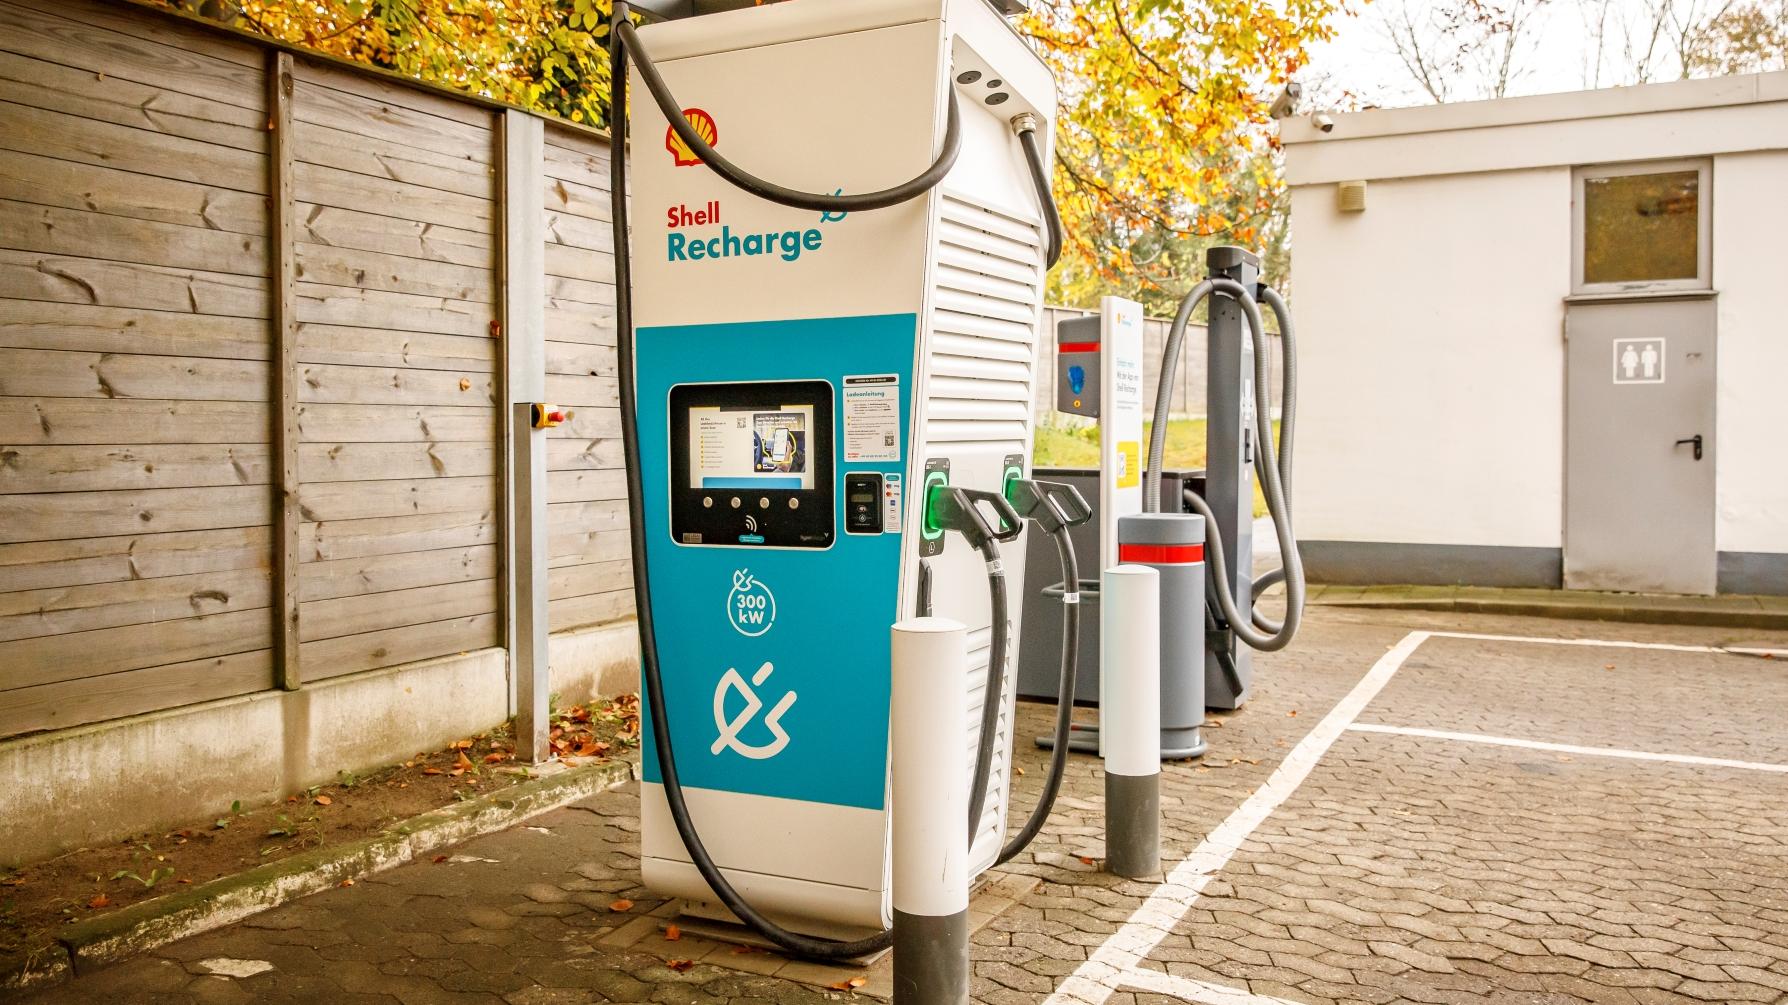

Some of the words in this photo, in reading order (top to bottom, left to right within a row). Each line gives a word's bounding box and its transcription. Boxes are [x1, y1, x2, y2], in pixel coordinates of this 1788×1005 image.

[667, 201, 720, 228] Shell
[668, 226, 823, 262] Recharge
[737, 594, 766, 609] 300
[738, 609, 765, 625] kW
